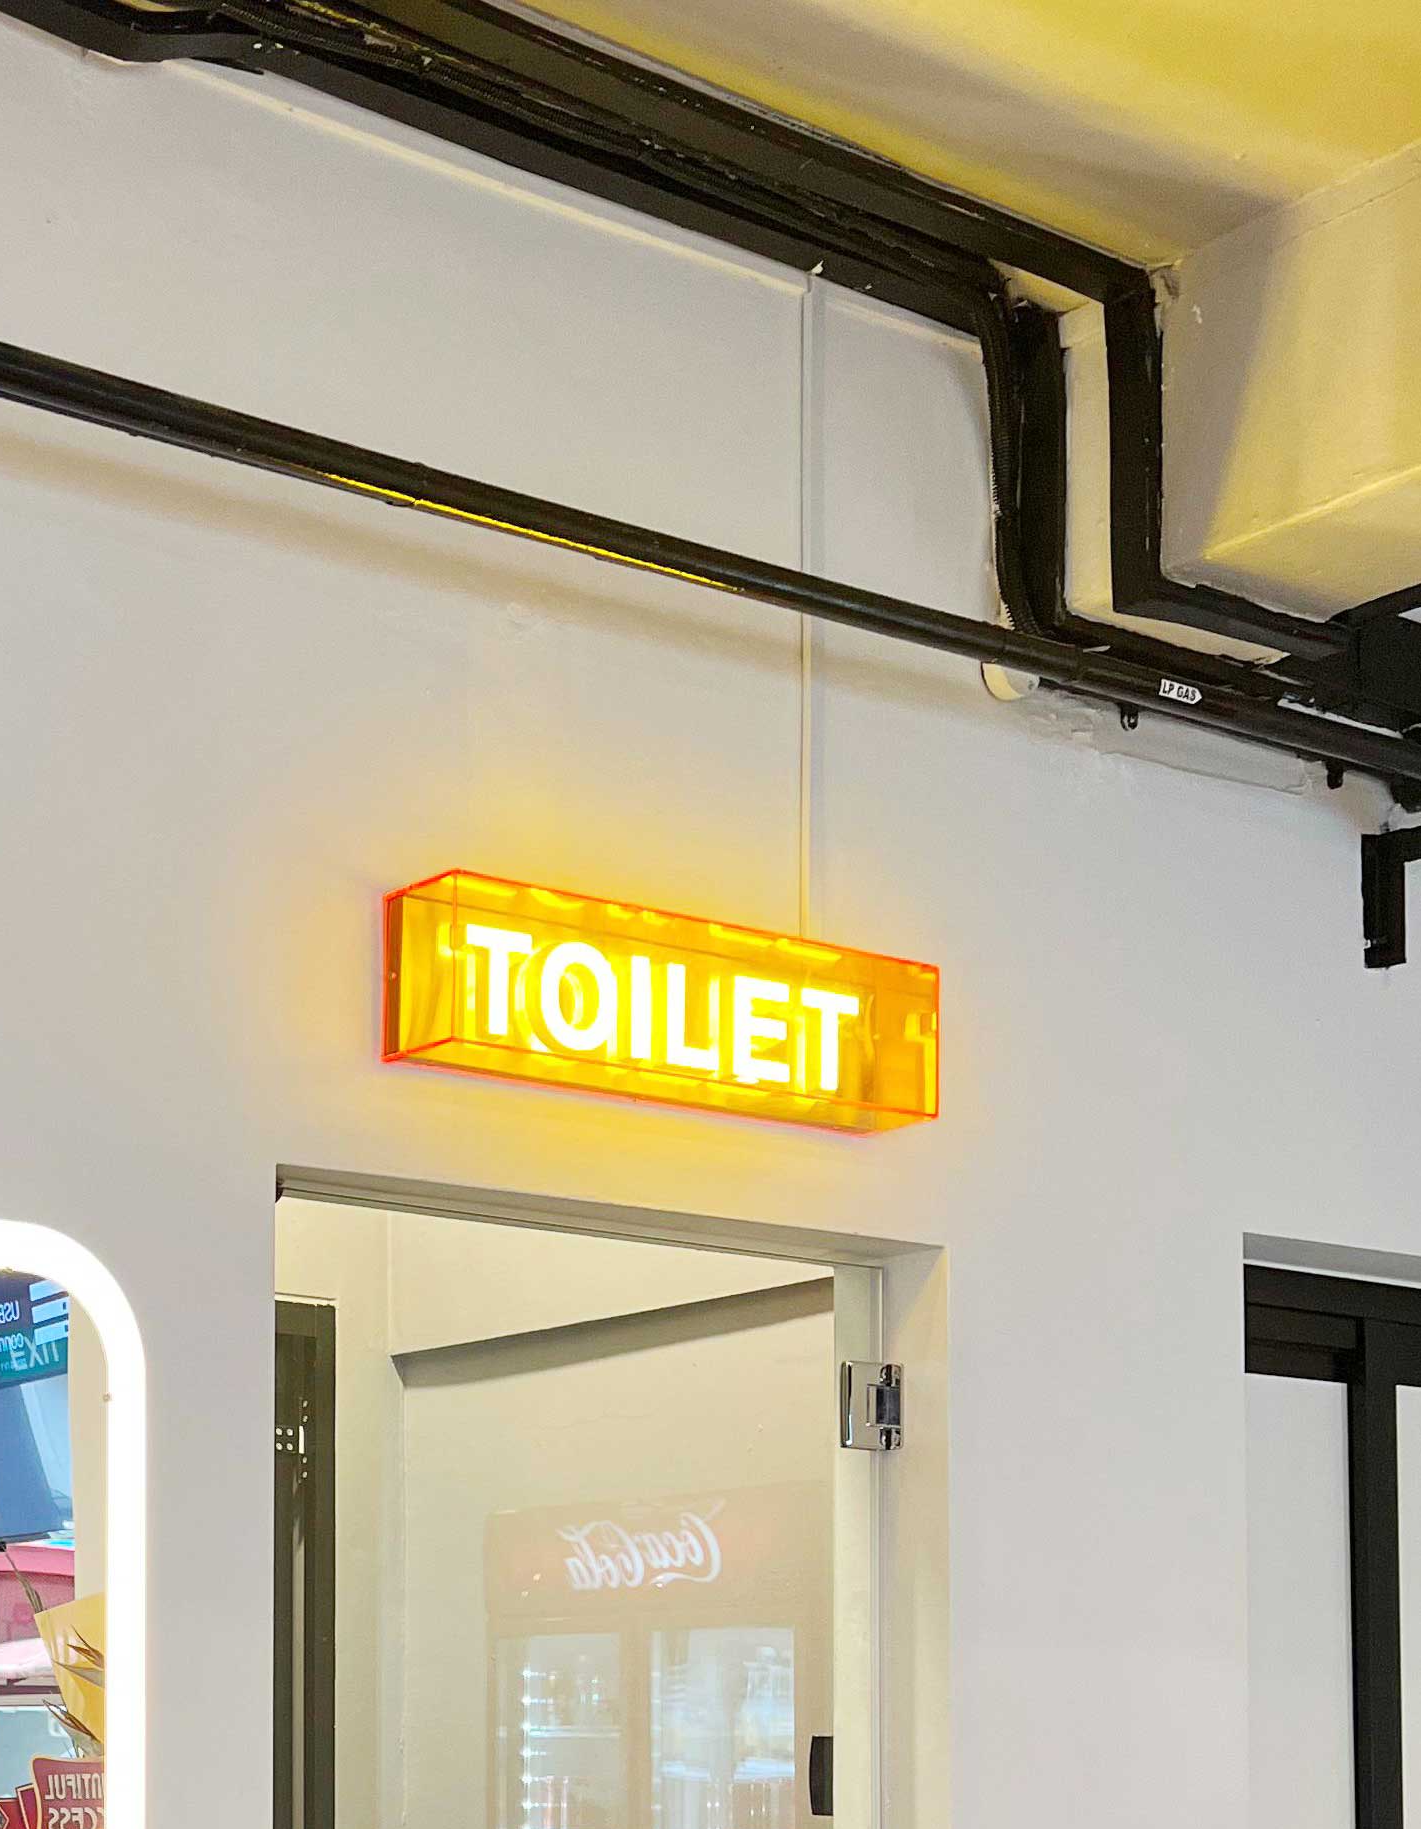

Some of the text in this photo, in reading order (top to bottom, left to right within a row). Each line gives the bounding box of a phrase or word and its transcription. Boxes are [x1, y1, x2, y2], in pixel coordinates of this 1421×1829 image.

[1162, 681, 1197, 701] LP GAS
[465, 923, 860, 1092] TOILET
